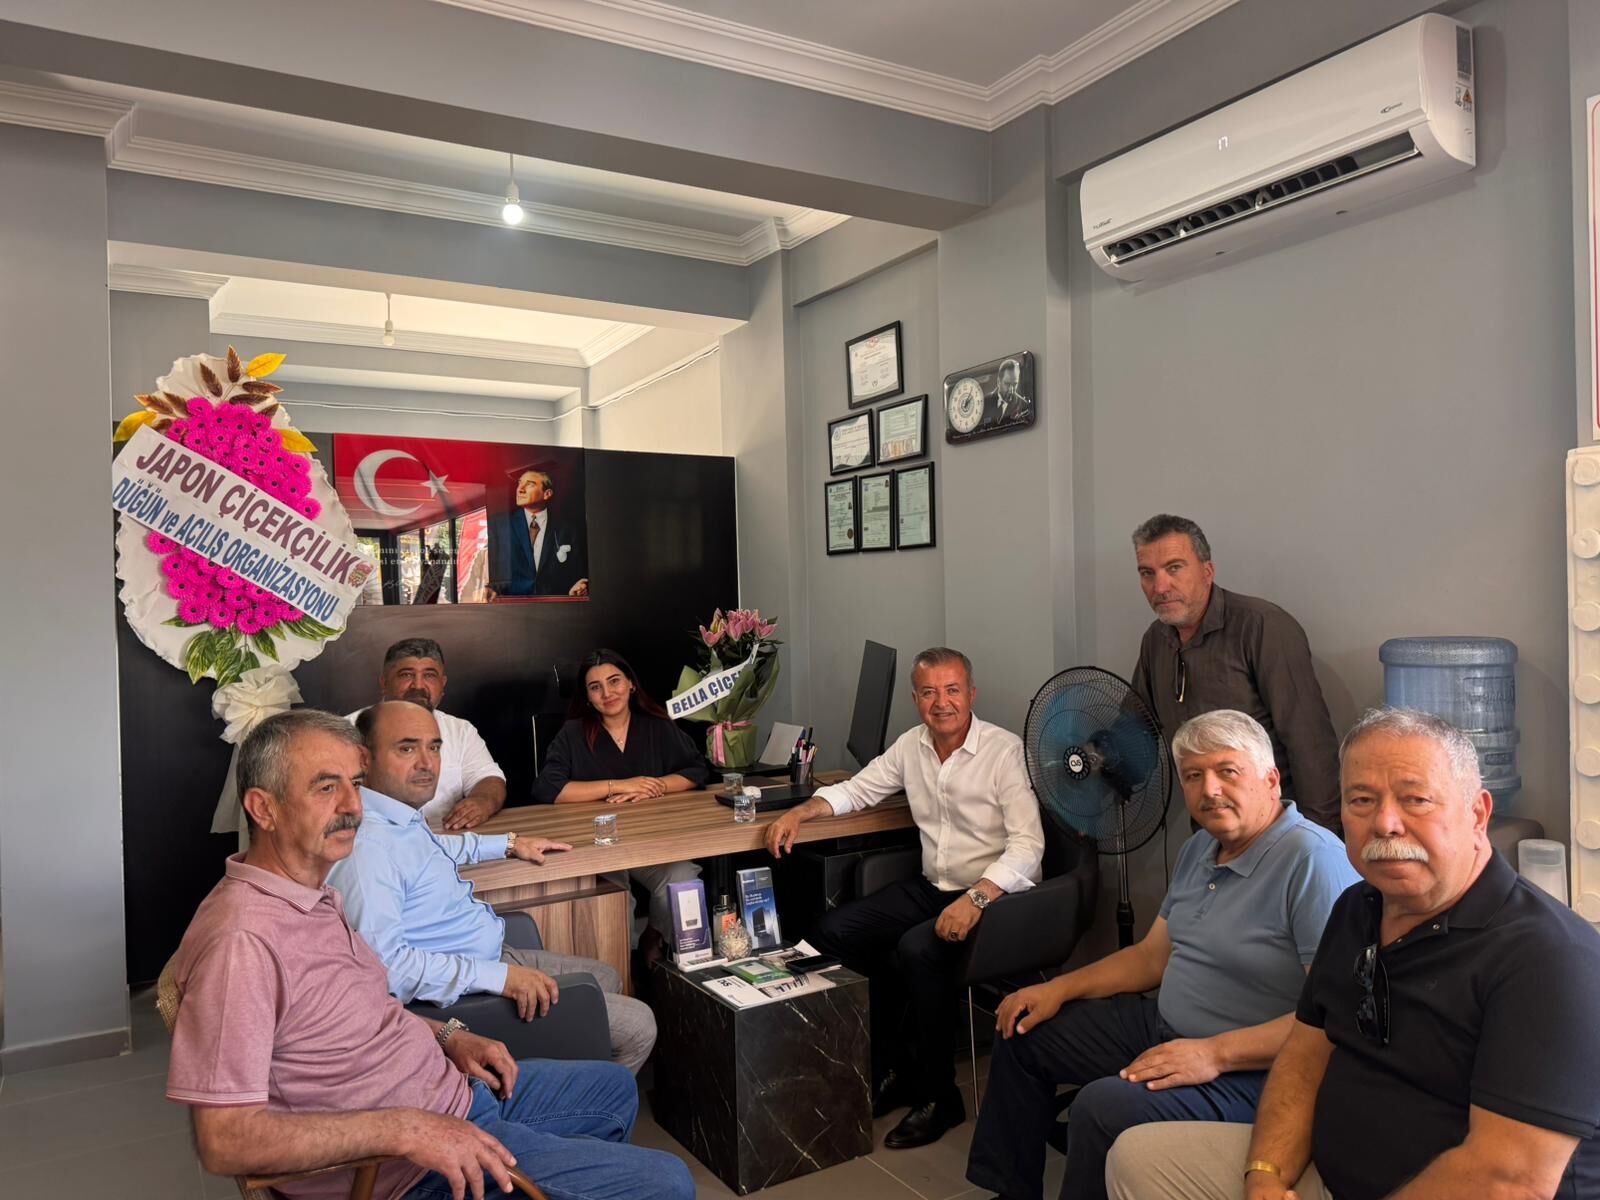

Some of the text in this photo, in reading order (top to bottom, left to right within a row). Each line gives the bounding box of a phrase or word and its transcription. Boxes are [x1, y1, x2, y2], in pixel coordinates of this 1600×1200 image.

[112, 477, 340, 622] DÜĞÜN ve AÇILIŞ ORGANİZASYONU
[136, 442, 360, 585] JAPON ÇİÇEKÇİLİK
[672, 687, 708, 715] BELLA
